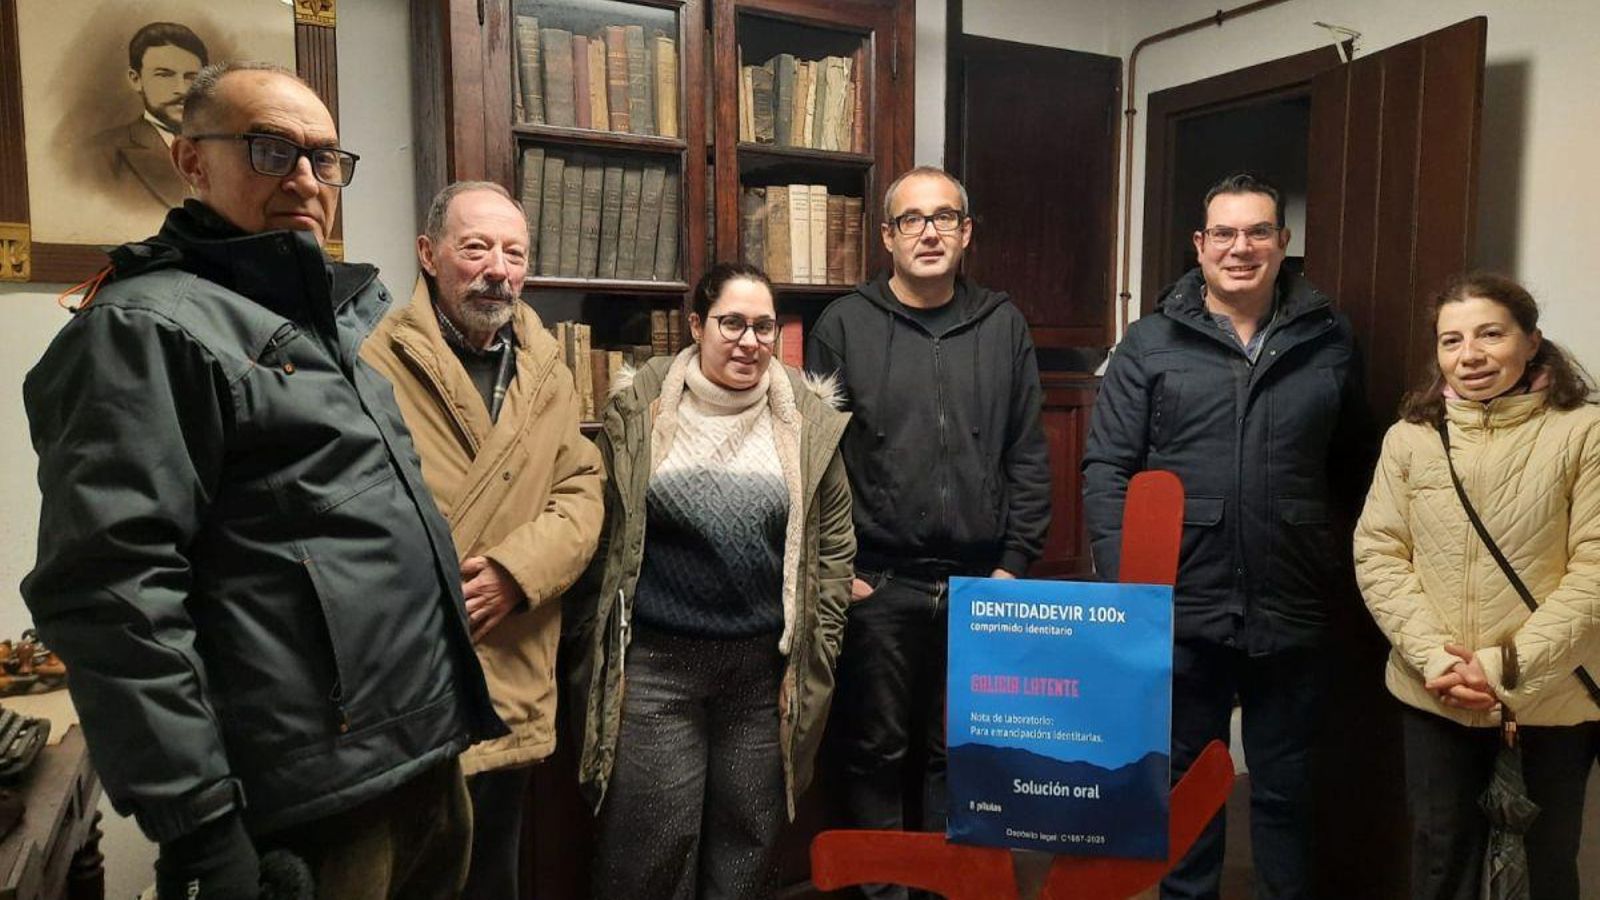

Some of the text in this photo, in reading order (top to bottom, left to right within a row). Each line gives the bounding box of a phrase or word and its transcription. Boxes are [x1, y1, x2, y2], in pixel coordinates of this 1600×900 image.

[971, 600, 1126, 623] IDENTIDADEVIR 100x
[970, 622, 1072, 636] comprimido identitario
[970, 712, 990, 722] Nota
[993, 713, 1002, 723] de
[970, 726, 988, 736] Para
[1013, 779, 1100, 799] Solución oral
